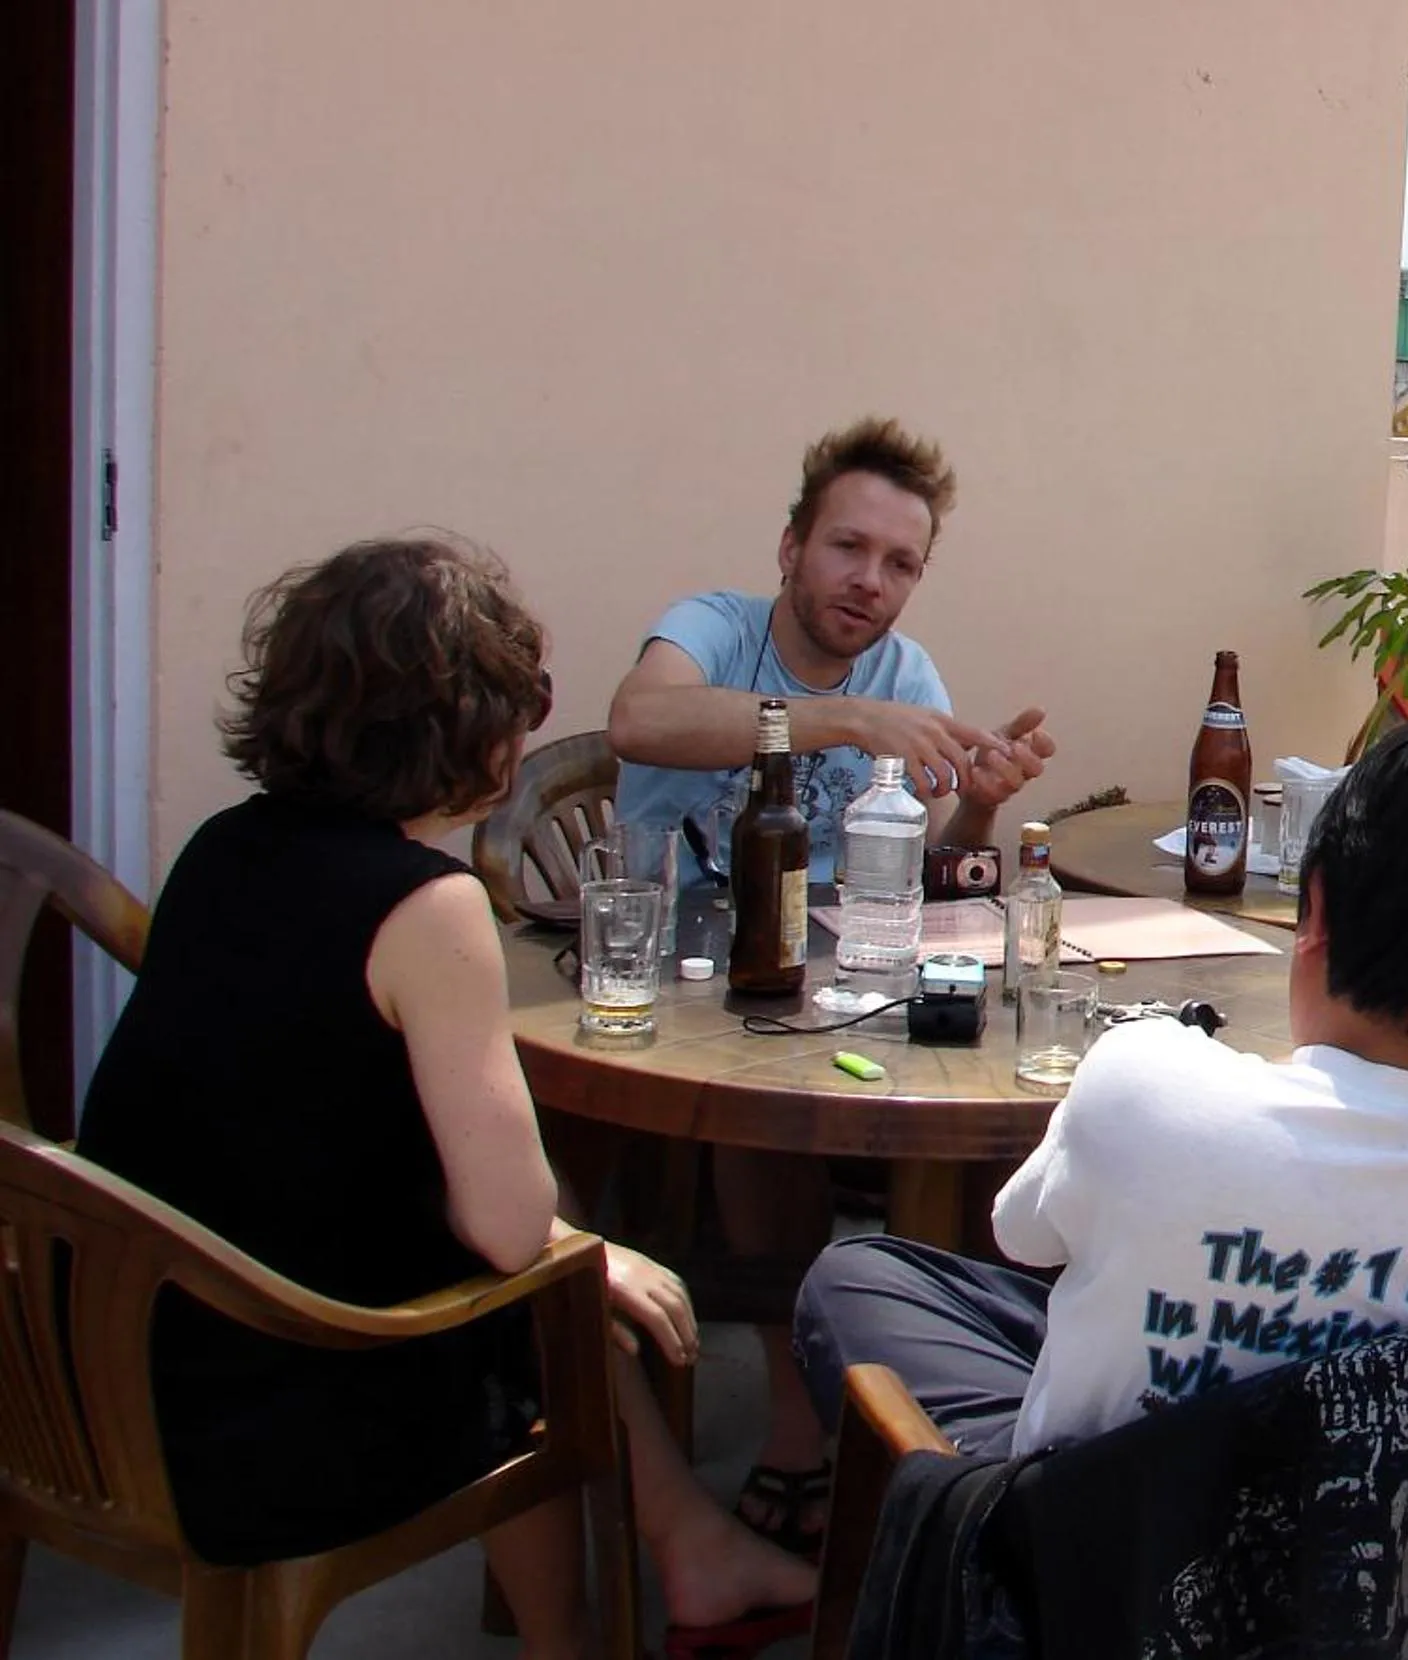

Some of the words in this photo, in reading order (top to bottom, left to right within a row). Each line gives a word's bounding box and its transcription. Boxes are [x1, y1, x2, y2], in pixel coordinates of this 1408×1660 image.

[1188, 819, 1242, 834] EVEREST
[1202, 1227, 1312, 1294] The
[1144, 1289, 1198, 1339] In
